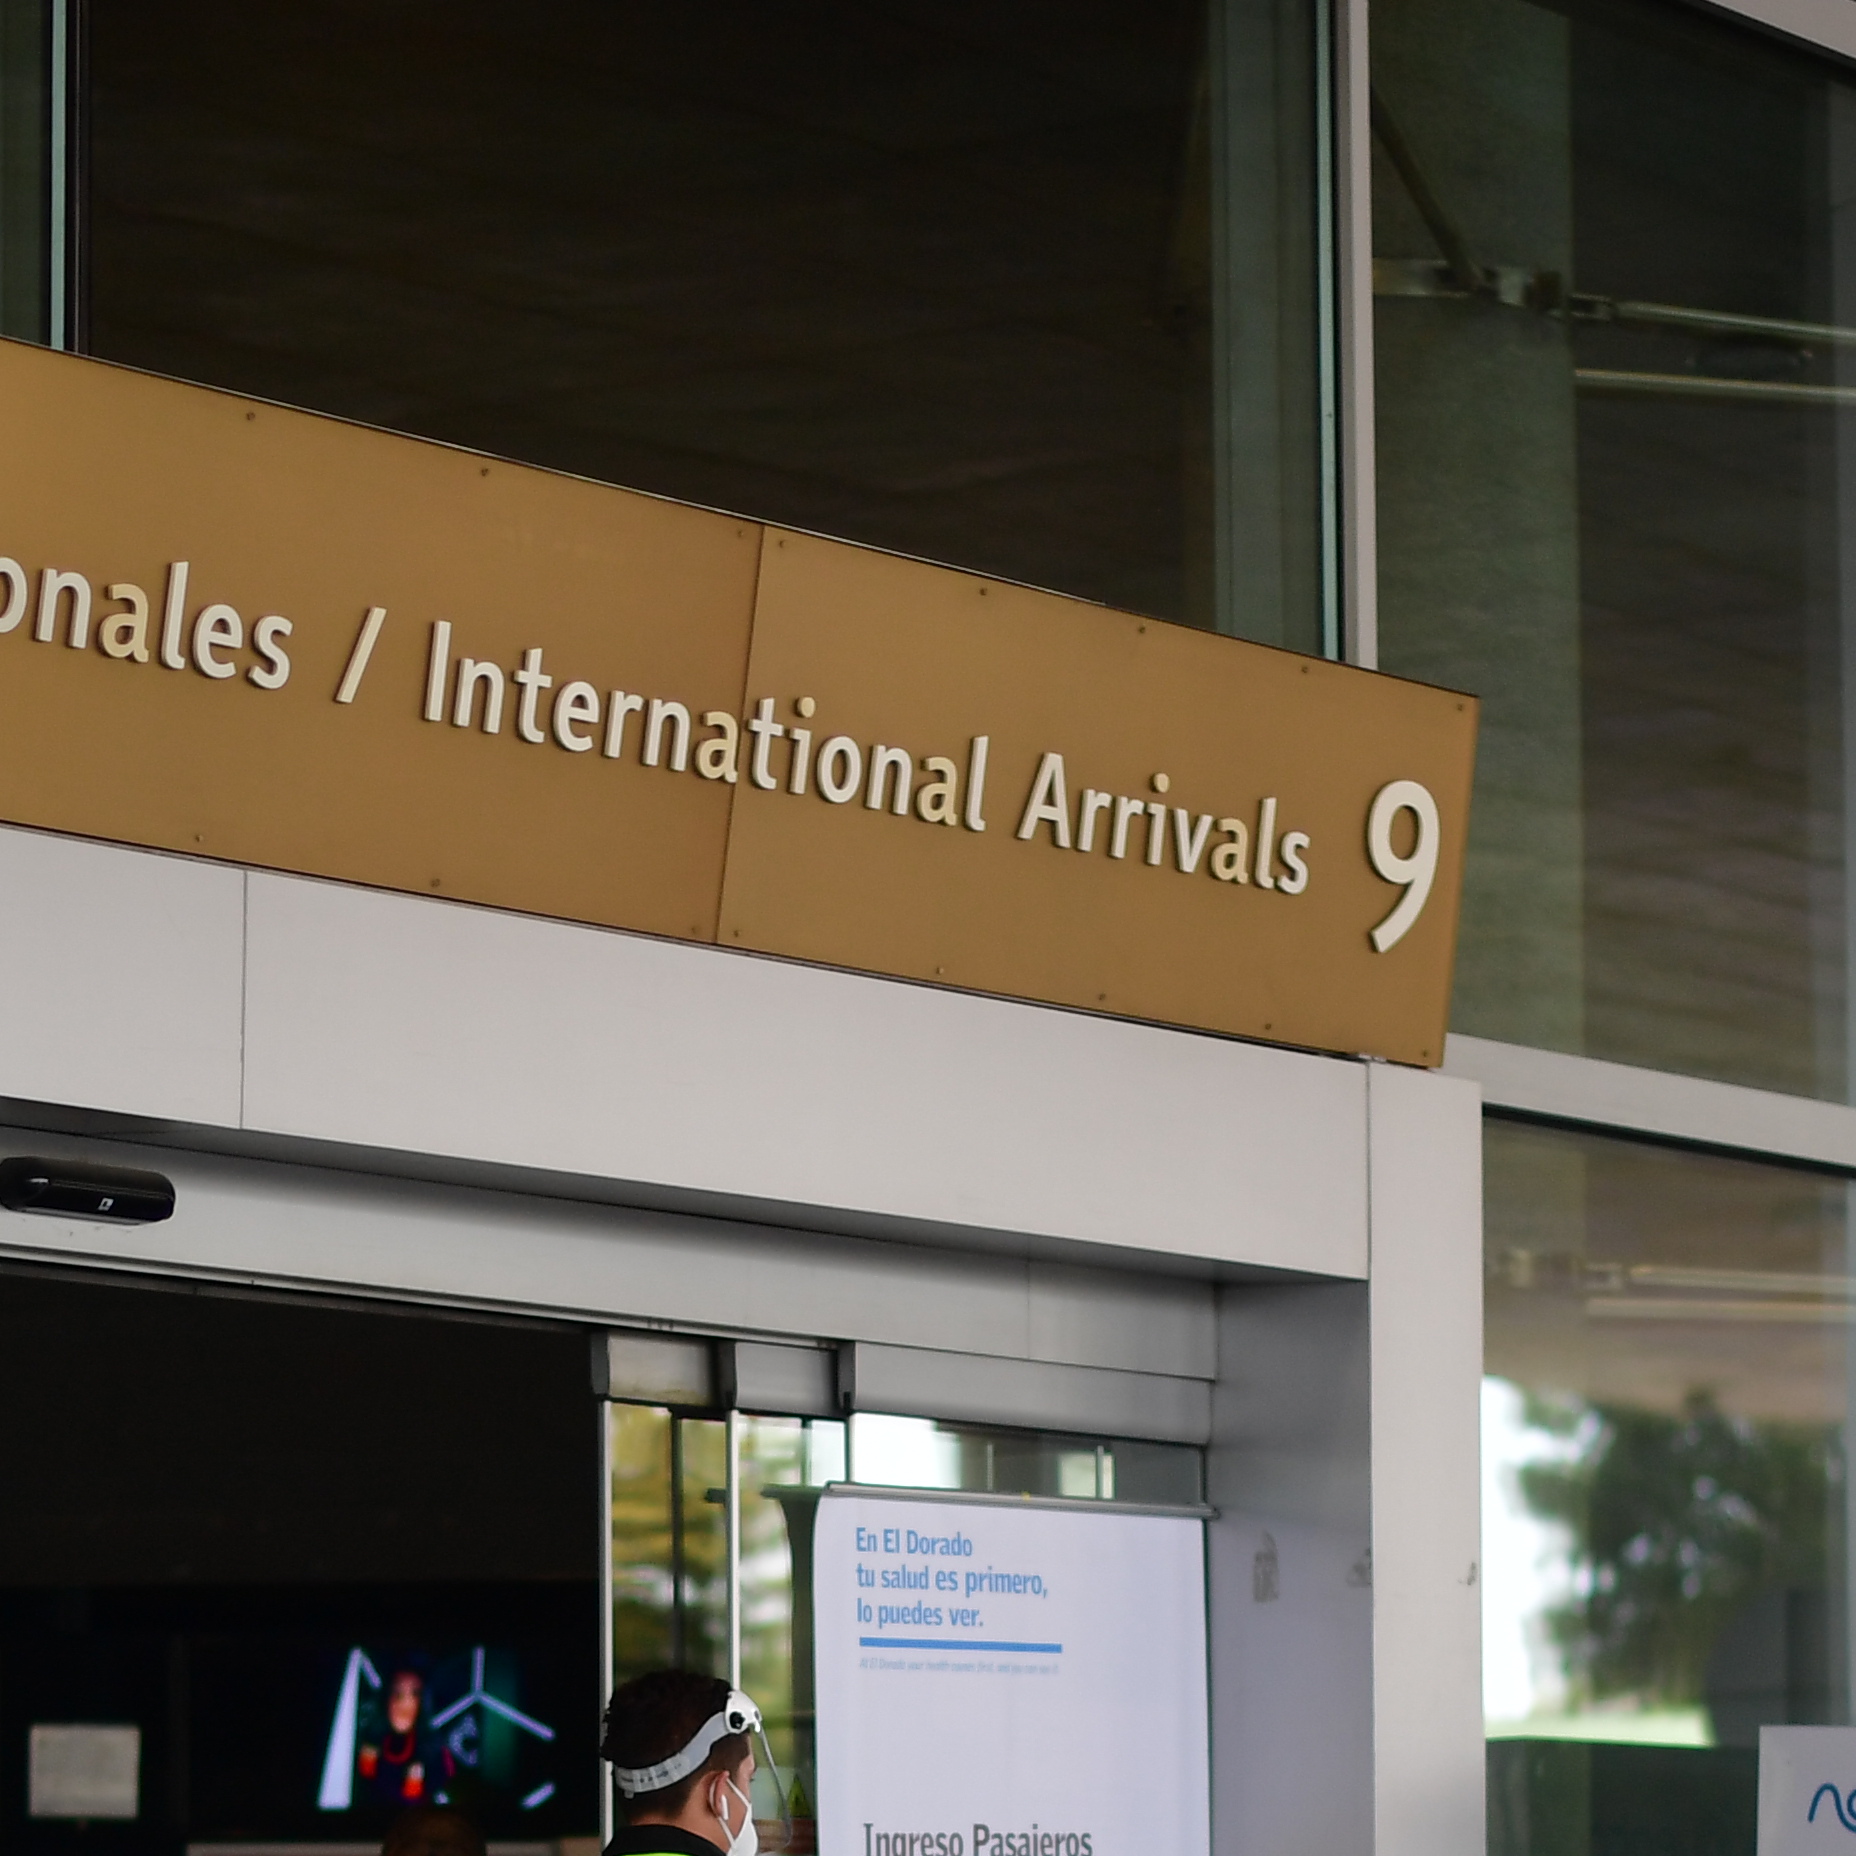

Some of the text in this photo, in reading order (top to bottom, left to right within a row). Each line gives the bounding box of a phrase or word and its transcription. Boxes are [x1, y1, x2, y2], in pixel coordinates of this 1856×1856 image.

[422, 620, 986, 834] International
[1017, 752, 1310, 895] Arrivals
[1365, 780, 1441, 954] 9
[856, 1527, 973, 1557] En El Dorado
[856, 1563, 1048, 1599] tu salud es primero,
[857, 1598, 984, 1629] lo puedes ver.
